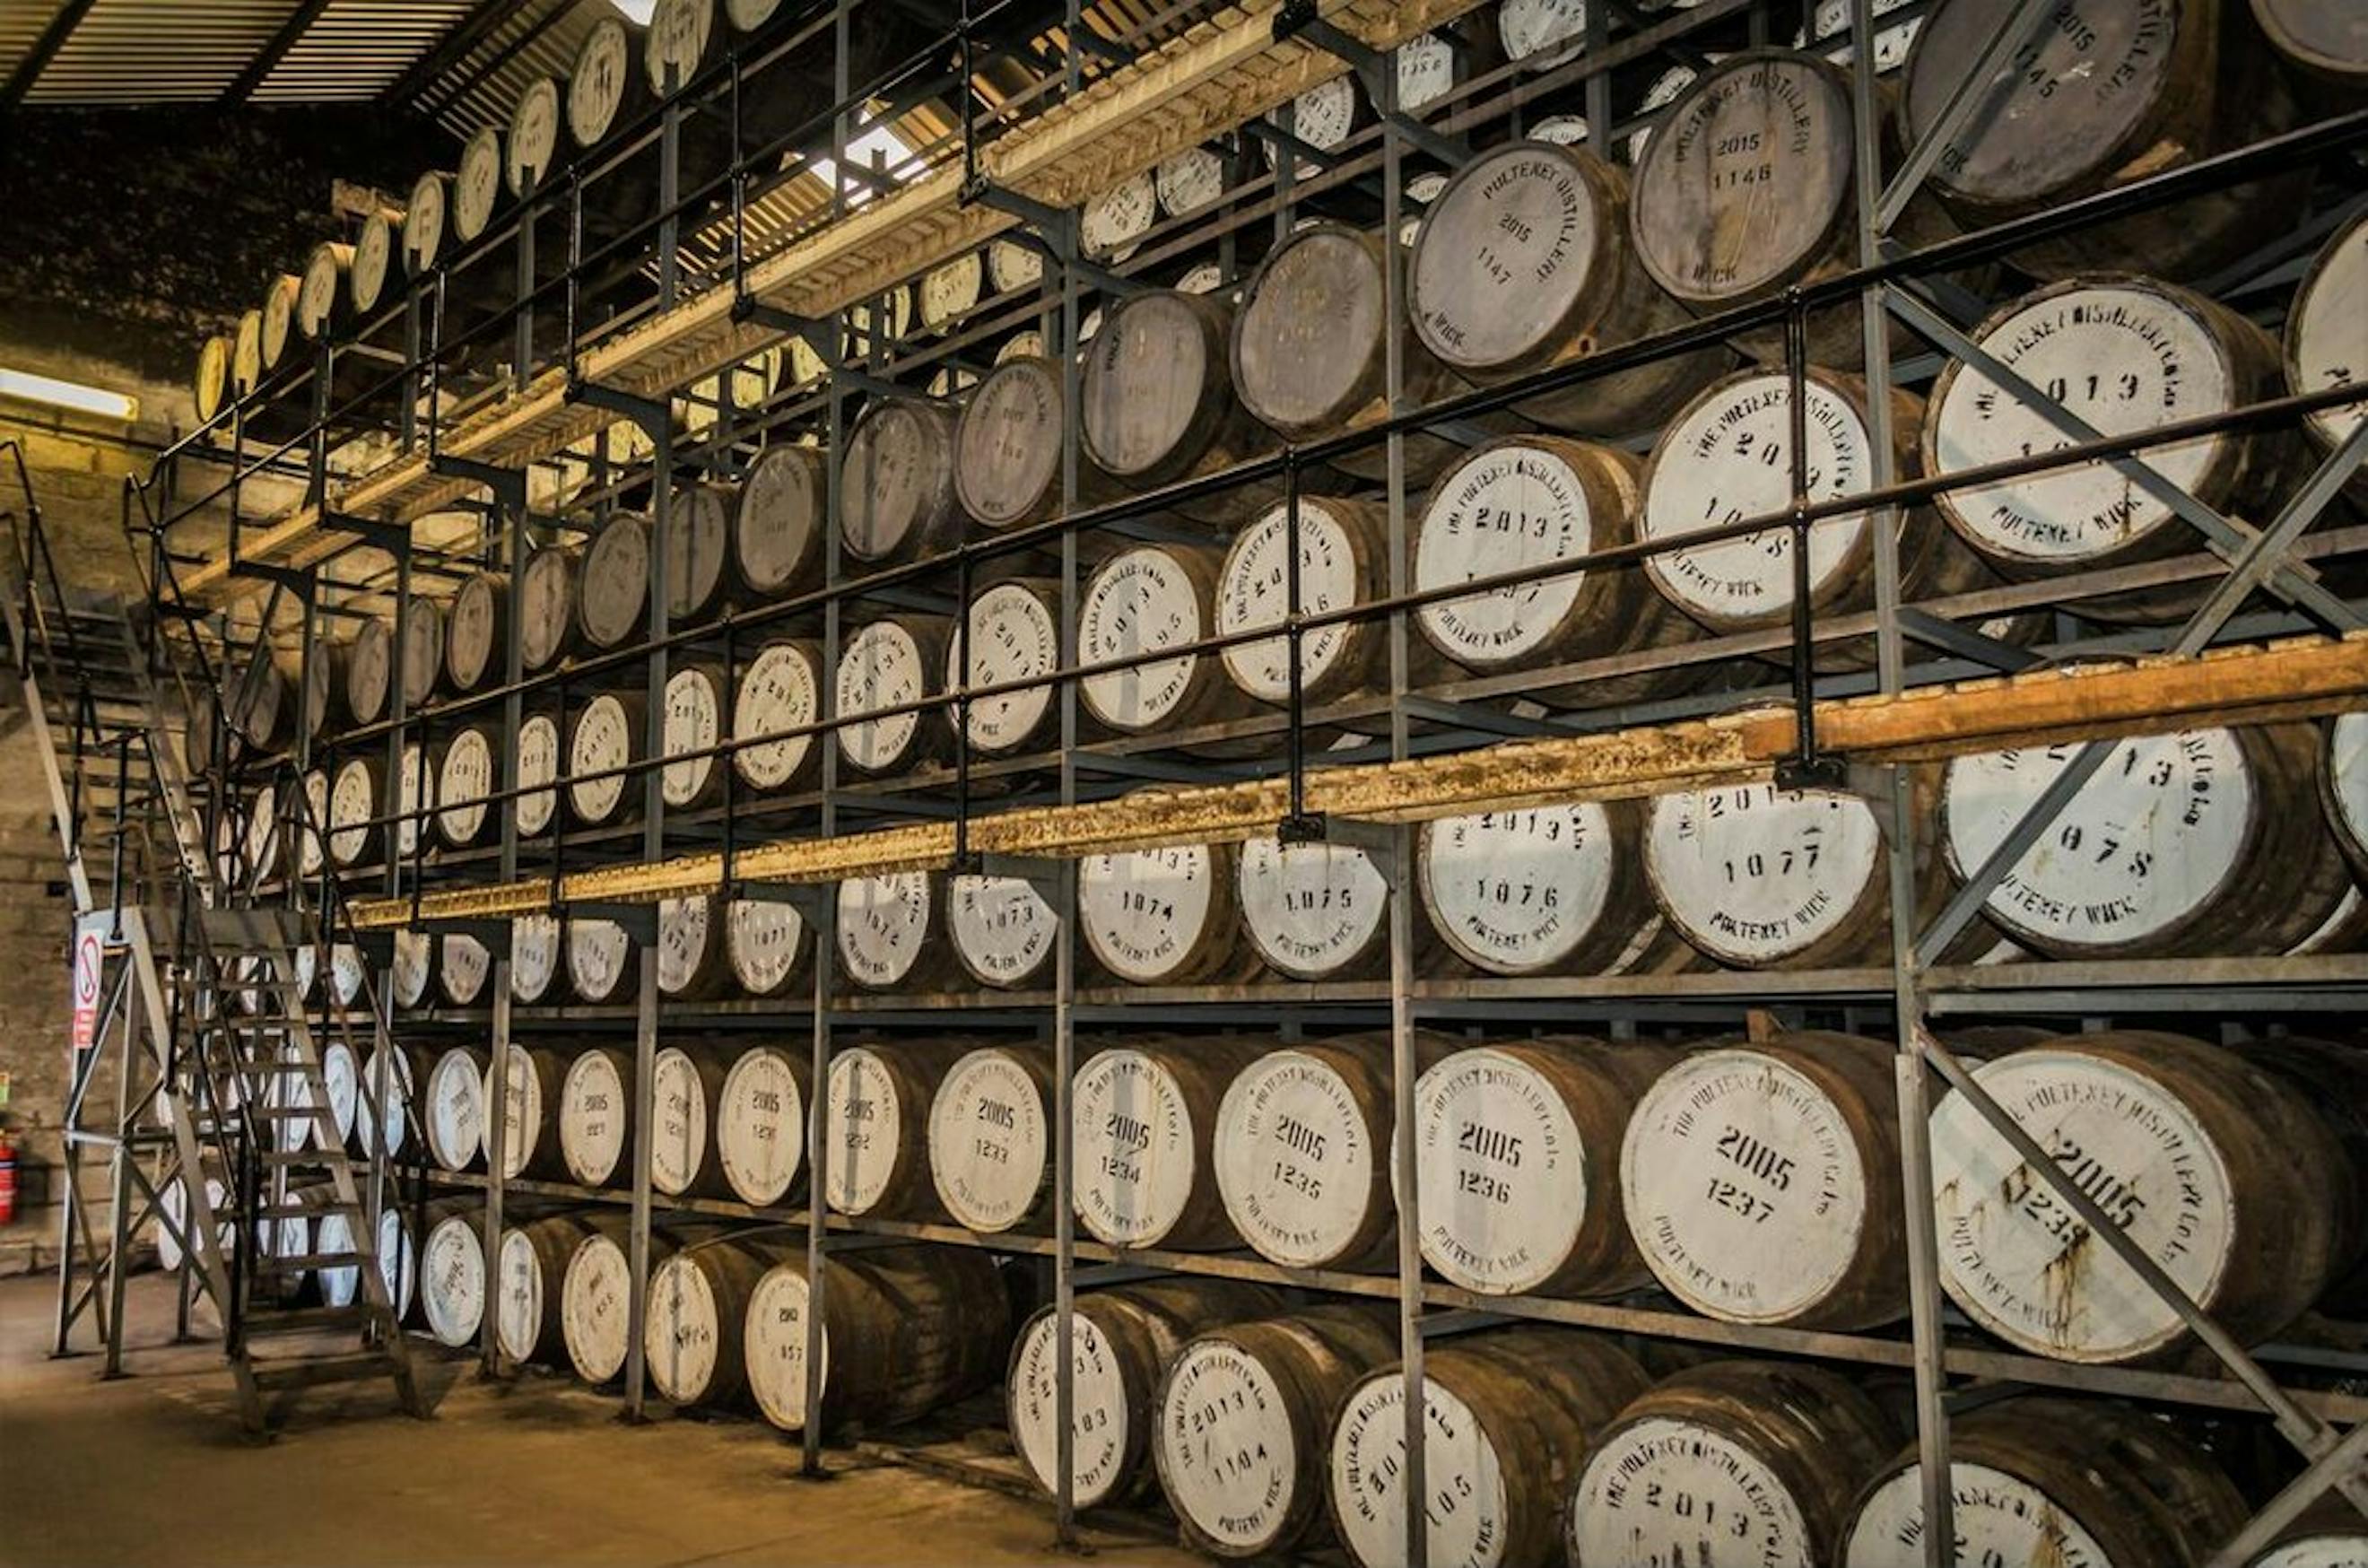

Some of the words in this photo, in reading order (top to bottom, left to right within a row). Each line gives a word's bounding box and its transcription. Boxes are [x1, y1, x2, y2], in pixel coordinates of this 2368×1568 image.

[1717, 135, 1760, 157] 2015
[1938, 143, 1969, 174] ICK
[1483, 161, 1558, 200] PULTENEY
[1537, 178, 1578, 283] DISTILLERY
[1499, 213, 1534, 243] 2015
[1477, 247, 1512, 285] 1147
[1435, 311, 1467, 347] WICK
[2050, 372, 2138, 406] 013
[1734, 431, 1821, 489] 203
[1476, 507, 1548, 539] 2013
[1254, 548, 1312, 598] 203
[1725, 843, 1819, 883] 1077
[1124, 890, 1173, 922] 1074
[1285, 888, 1352, 911] 1075
[1477, 878, 1558, 908] 1076
[986, 906, 1033, 932] 1073
[1709, 909, 1790, 941] PULTENEY
[977, 1096, 1015, 1130] 2005
[1105, 1111, 1151, 1150] 2005
[1673, 1109, 1694, 1138] THE
[975, 1137, 1009, 1165] 1233
[1274, 1112, 1328, 1163] 2005
[1458, 1121, 1523, 1169] 2005
[1101, 1154, 1142, 1185] 1234
[1716, 1125, 1796, 1191] 2005
[1274, 1161, 1322, 1201] 1235
[1458, 1169, 1512, 1205] 1236
[2052, 1138, 2146, 1232] 2005
[1706, 1177, 1775, 1224] 1237
[1191, 1389, 1245, 1434] 2013
[1213, 1442, 1267, 1485] 1104
[1370, 1439, 1406, 1495] 201
[1606, 1475, 1627, 1509] THE
[1617, 1435, 1687, 1482] PULTENEY
[1425, 1474, 1472, 1528] 105
[1646, 1480, 1749, 1538] 2013
